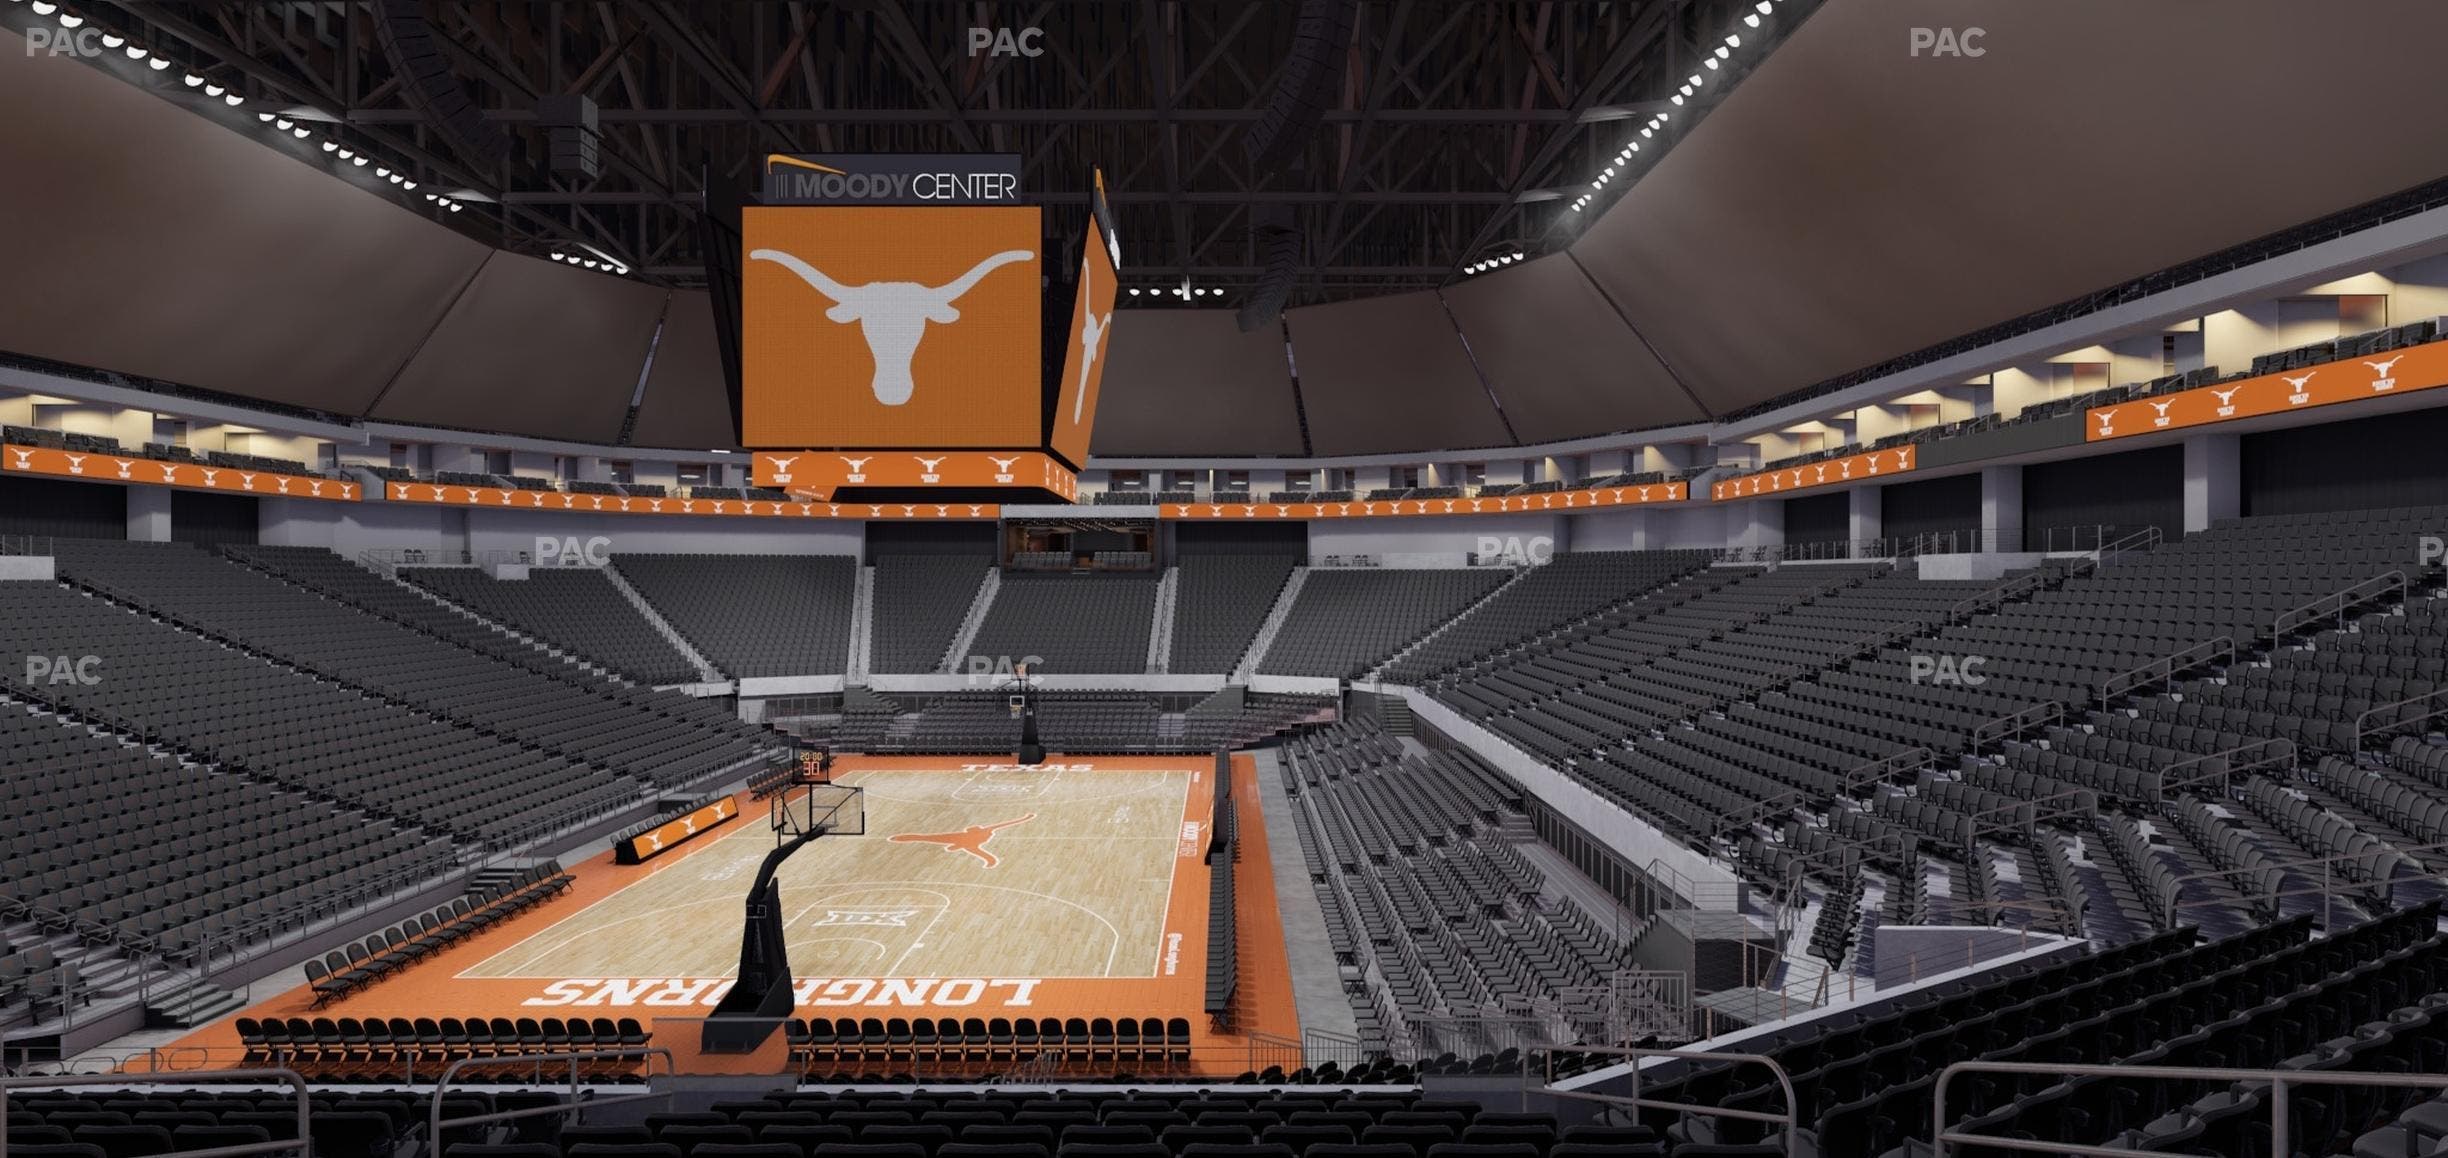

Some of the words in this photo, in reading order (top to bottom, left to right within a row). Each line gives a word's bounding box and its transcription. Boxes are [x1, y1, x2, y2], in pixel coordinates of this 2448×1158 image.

[795, 173, 910, 199] MOODY
[912, 173, 1017, 199] CENTER
[799, 751, 823, 761] 20:00
[803, 761, 820, 775] 30
[960, 764, 1094, 772] TEXAS
